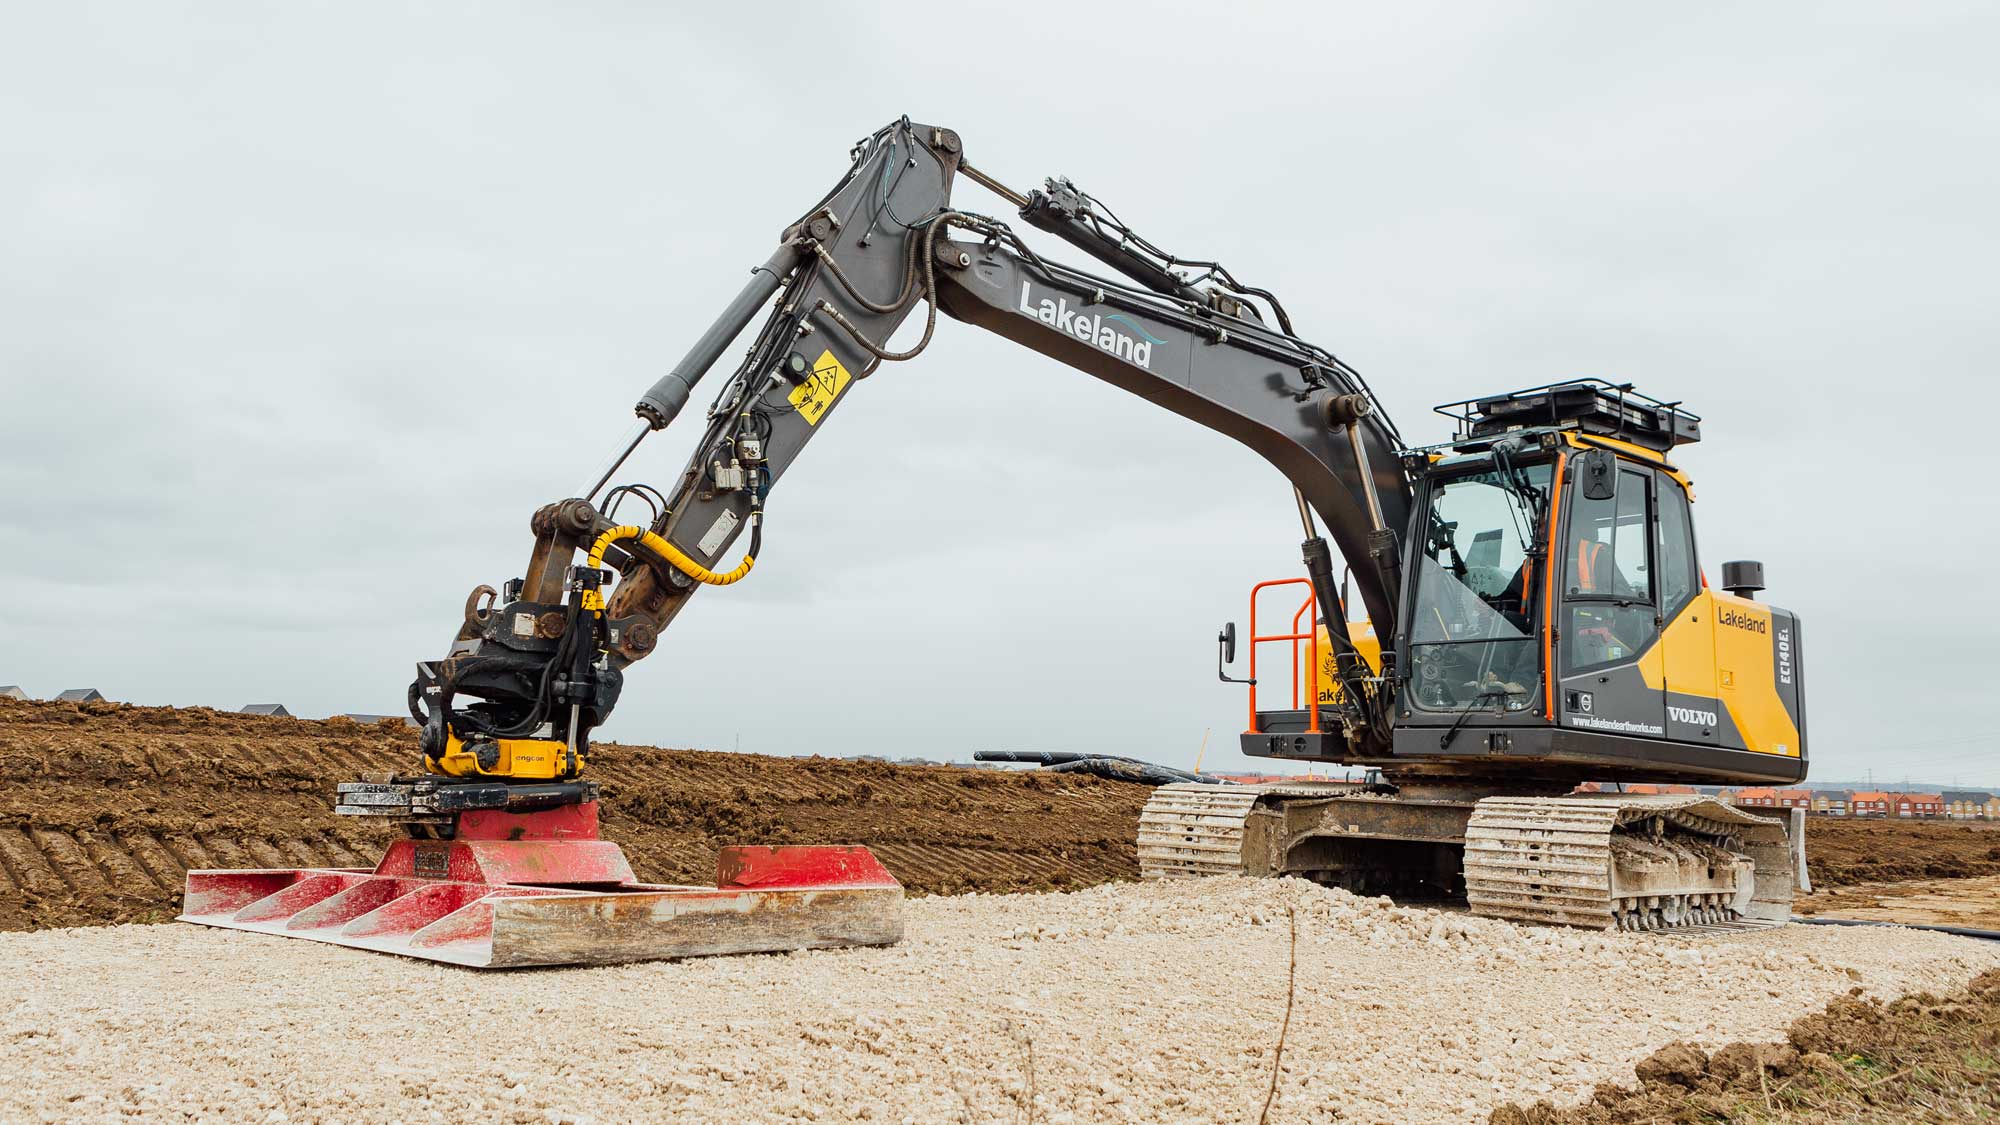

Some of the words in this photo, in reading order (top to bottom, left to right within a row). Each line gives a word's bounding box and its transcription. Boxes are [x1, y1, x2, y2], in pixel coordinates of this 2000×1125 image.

[1019, 280, 1152, 368] Lakeland
[1718, 606, 1766, 634] Lakeland
[1572, 716, 1662, 734] www.lakelandearthworks.com
[1667, 706, 1717, 727] VOLVO
